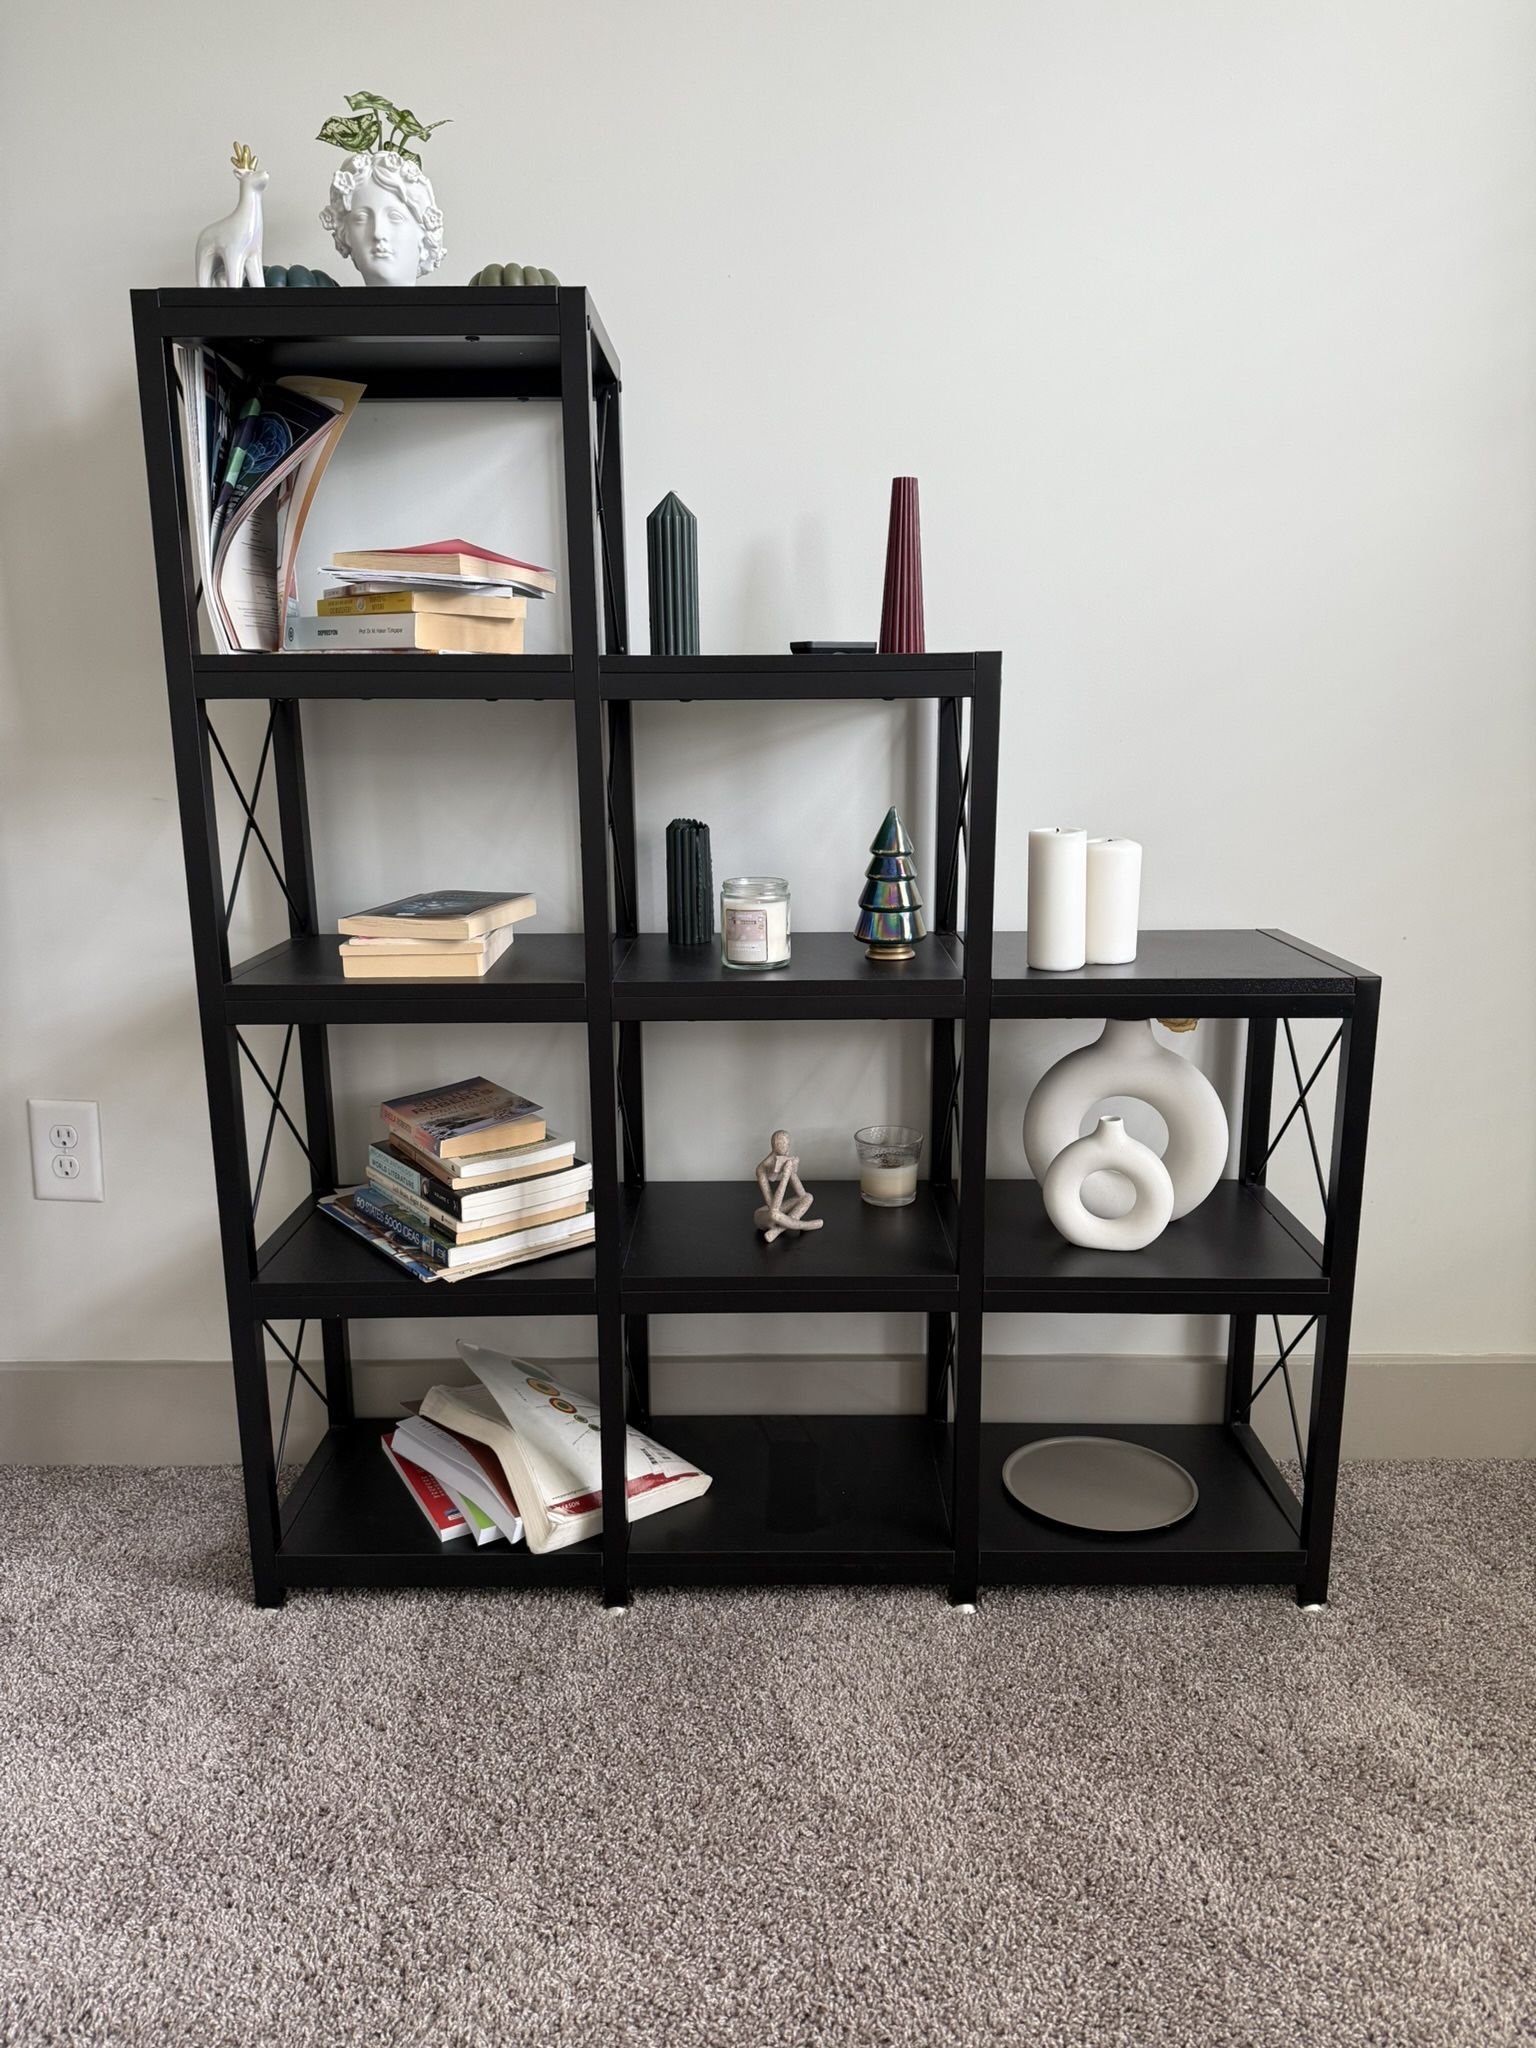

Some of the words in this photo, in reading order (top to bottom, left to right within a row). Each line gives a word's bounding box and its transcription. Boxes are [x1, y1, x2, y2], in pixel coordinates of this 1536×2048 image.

[410, 1087, 494, 1114] ROBERTS
[372, 1160, 387, 1174] WORLD
[388, 1167, 415, 1190] LITERATURE
[356, 1196, 365, 1209] 50
[365, 1201, 384, 1222] STATES
[384, 1213, 403, 1233] 5000
[402, 1225, 420, 1245] IDEAS
